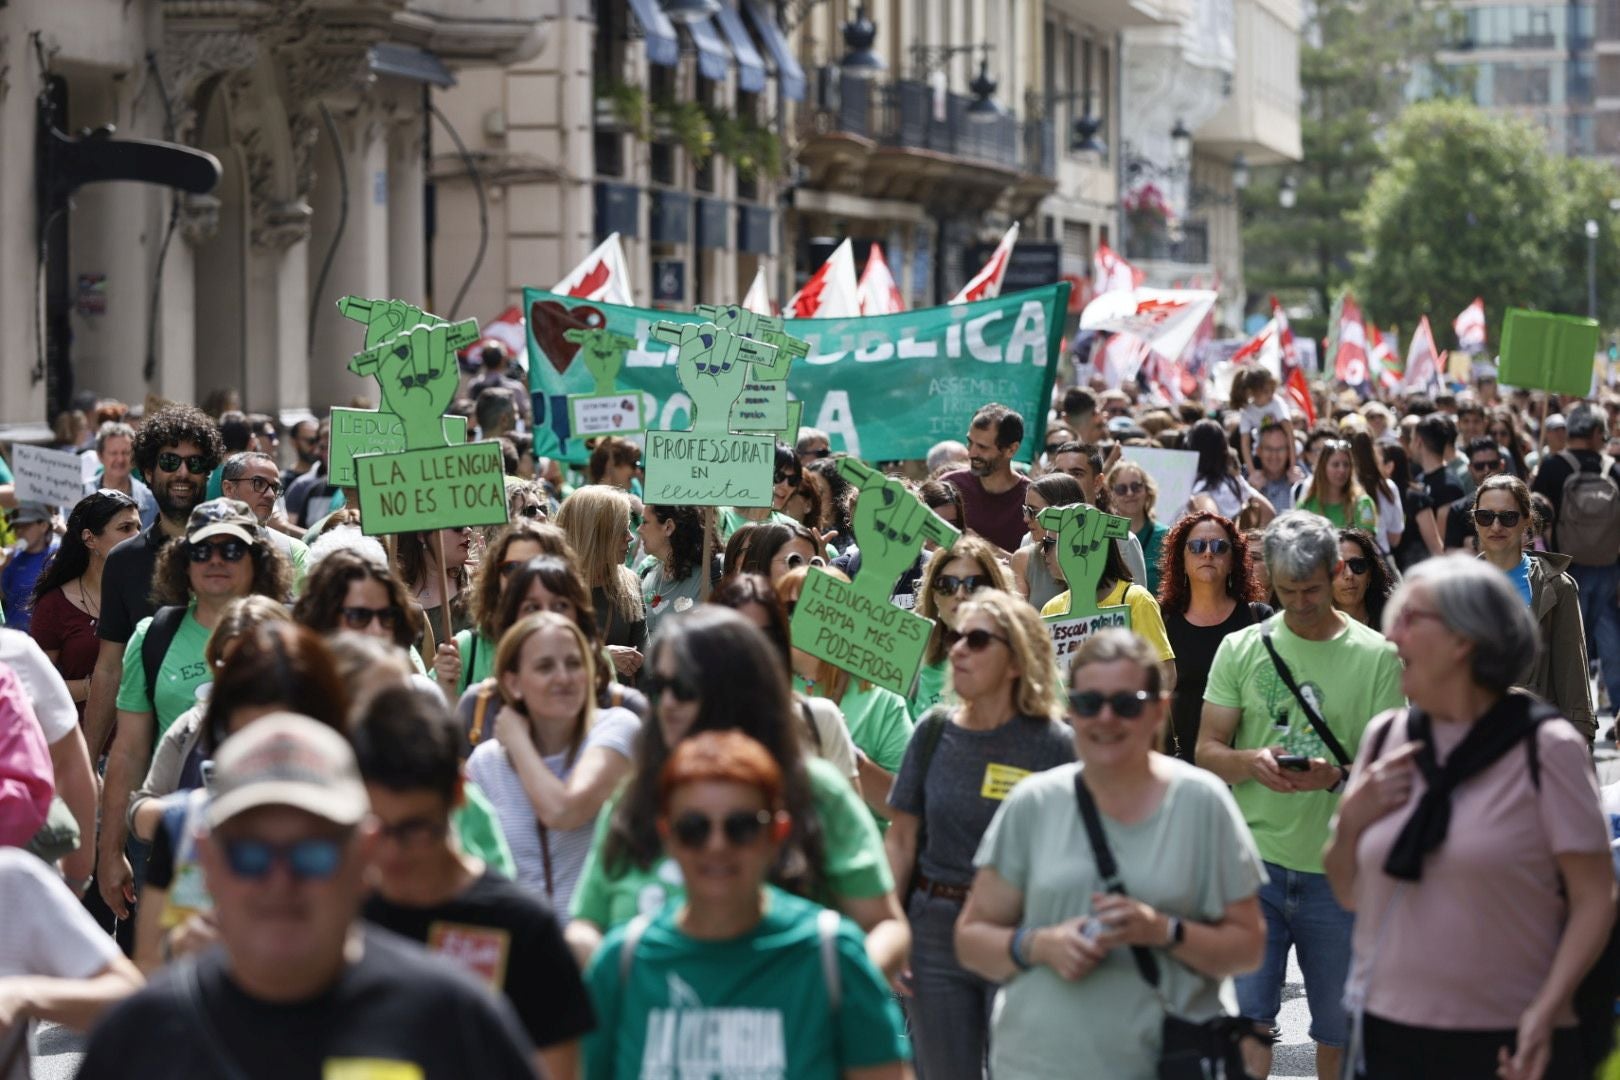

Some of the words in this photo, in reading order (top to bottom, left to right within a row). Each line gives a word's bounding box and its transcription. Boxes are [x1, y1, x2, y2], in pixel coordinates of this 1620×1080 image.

[804, 300, 1049, 367] ÚBLICA
[653, 436, 772, 464] PROFESSORAT
[369, 460, 406, 486] LA
[420, 453, 502, 482] LLENGUA
[691, 467, 709, 478] EN
[379, 491, 407, 517] NO
[415, 487, 437, 514] ES
[449, 483, 504, 509] TOCA
[804, 597, 855, 634] L'ARMA
[811, 574, 899, 627] L'EDUCACIÓ
[815, 626, 903, 690] PODEROSA
